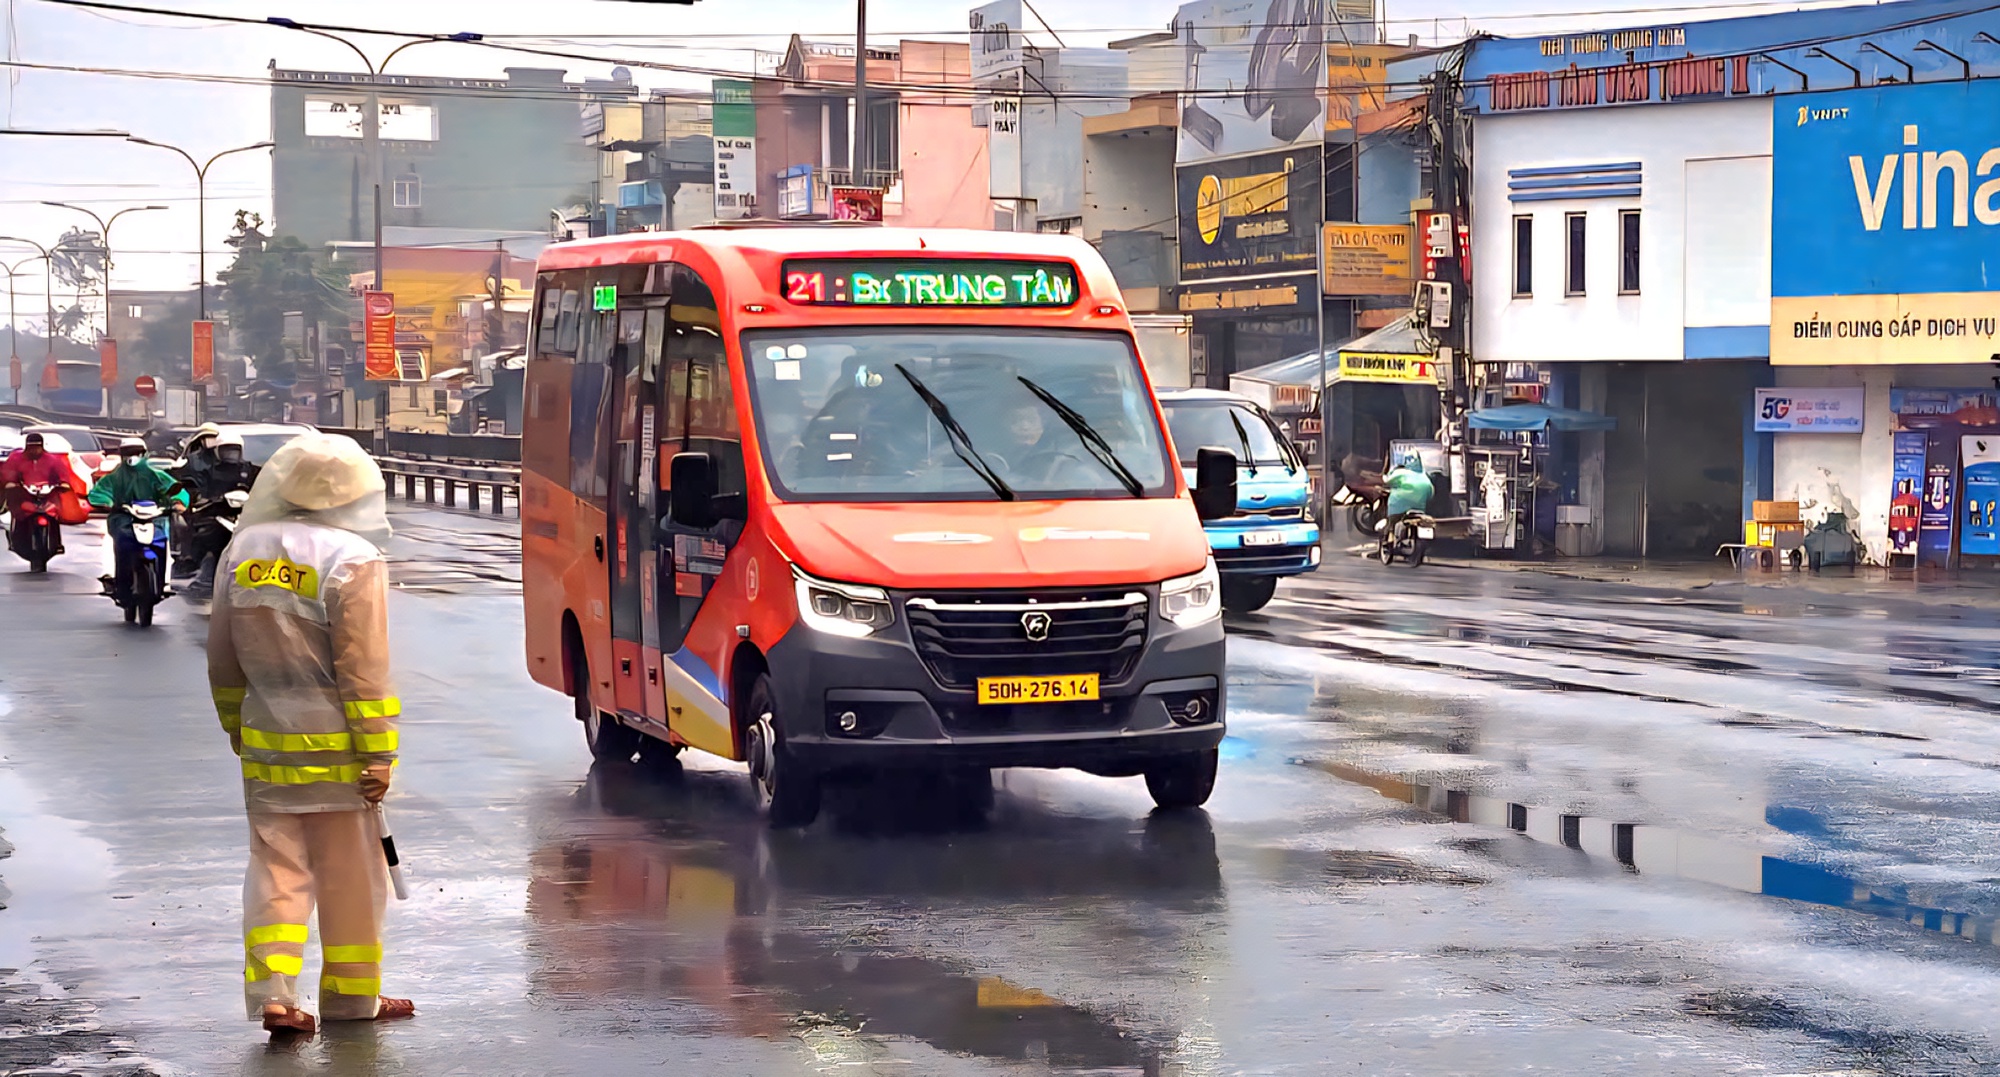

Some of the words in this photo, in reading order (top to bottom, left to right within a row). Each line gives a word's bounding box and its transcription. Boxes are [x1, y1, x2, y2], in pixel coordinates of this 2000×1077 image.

[1811, 107, 1850, 120] VNPT
[1849, 124, 2000, 231] vina
[787, 272, 825, 301] 21
[895, 273, 1007, 303] TRUNG
[1793, 311, 1832, 338] ĐIỂM
[1837, 320, 1883, 338] CUNG
[1927, 318, 1966, 340] DỊCH
[1973, 317, 1996, 340] VỤ
[1762, 397, 1790, 420] 5G
